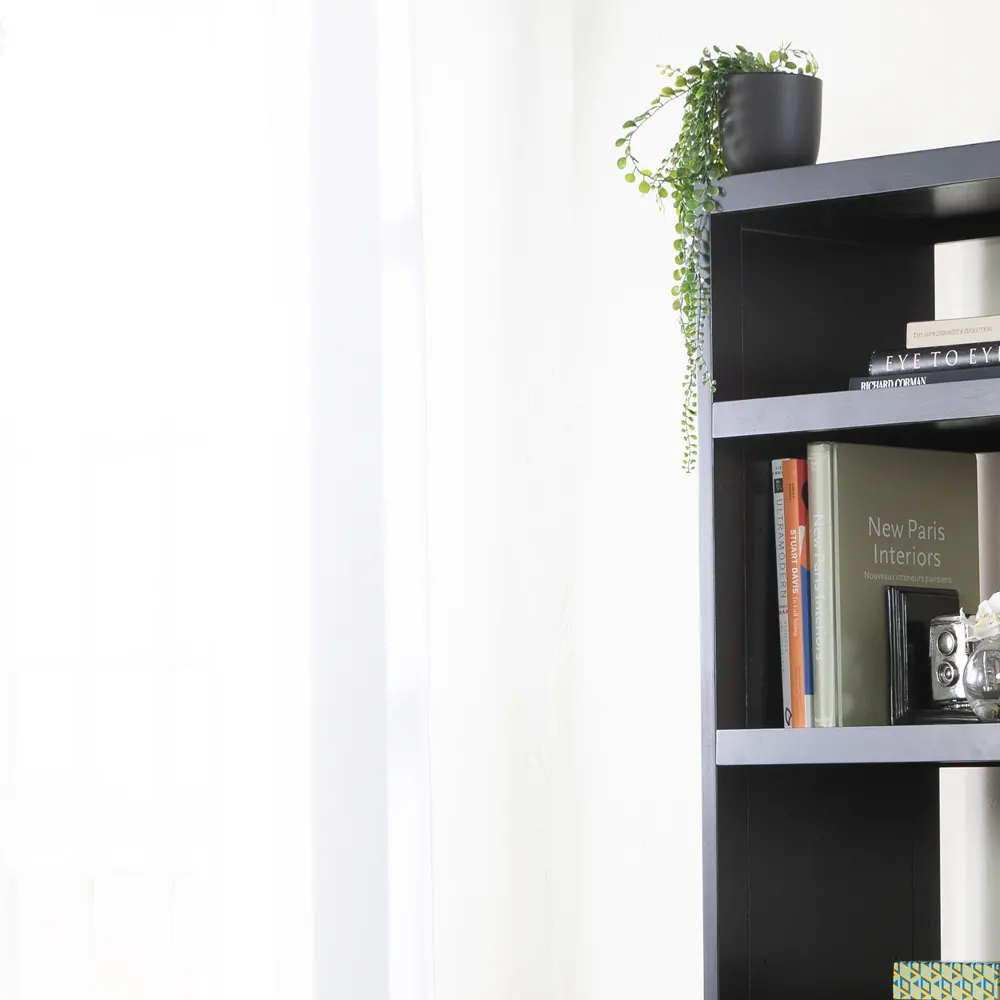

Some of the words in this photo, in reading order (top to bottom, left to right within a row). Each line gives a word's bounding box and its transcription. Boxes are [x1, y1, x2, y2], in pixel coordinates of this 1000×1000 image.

[886, 353, 920, 372] EYE
[930, 350, 958, 368] TO
[814, 514, 824, 548] New
[868, 516, 904, 538] New
[908, 519, 946, 540] Paris
[776, 499, 787, 598] ULTRAMODERN
[874, 544, 940, 566] Interiors
[814, 554, 825, 591] Paris
[815, 596, 826, 660] Interiors
